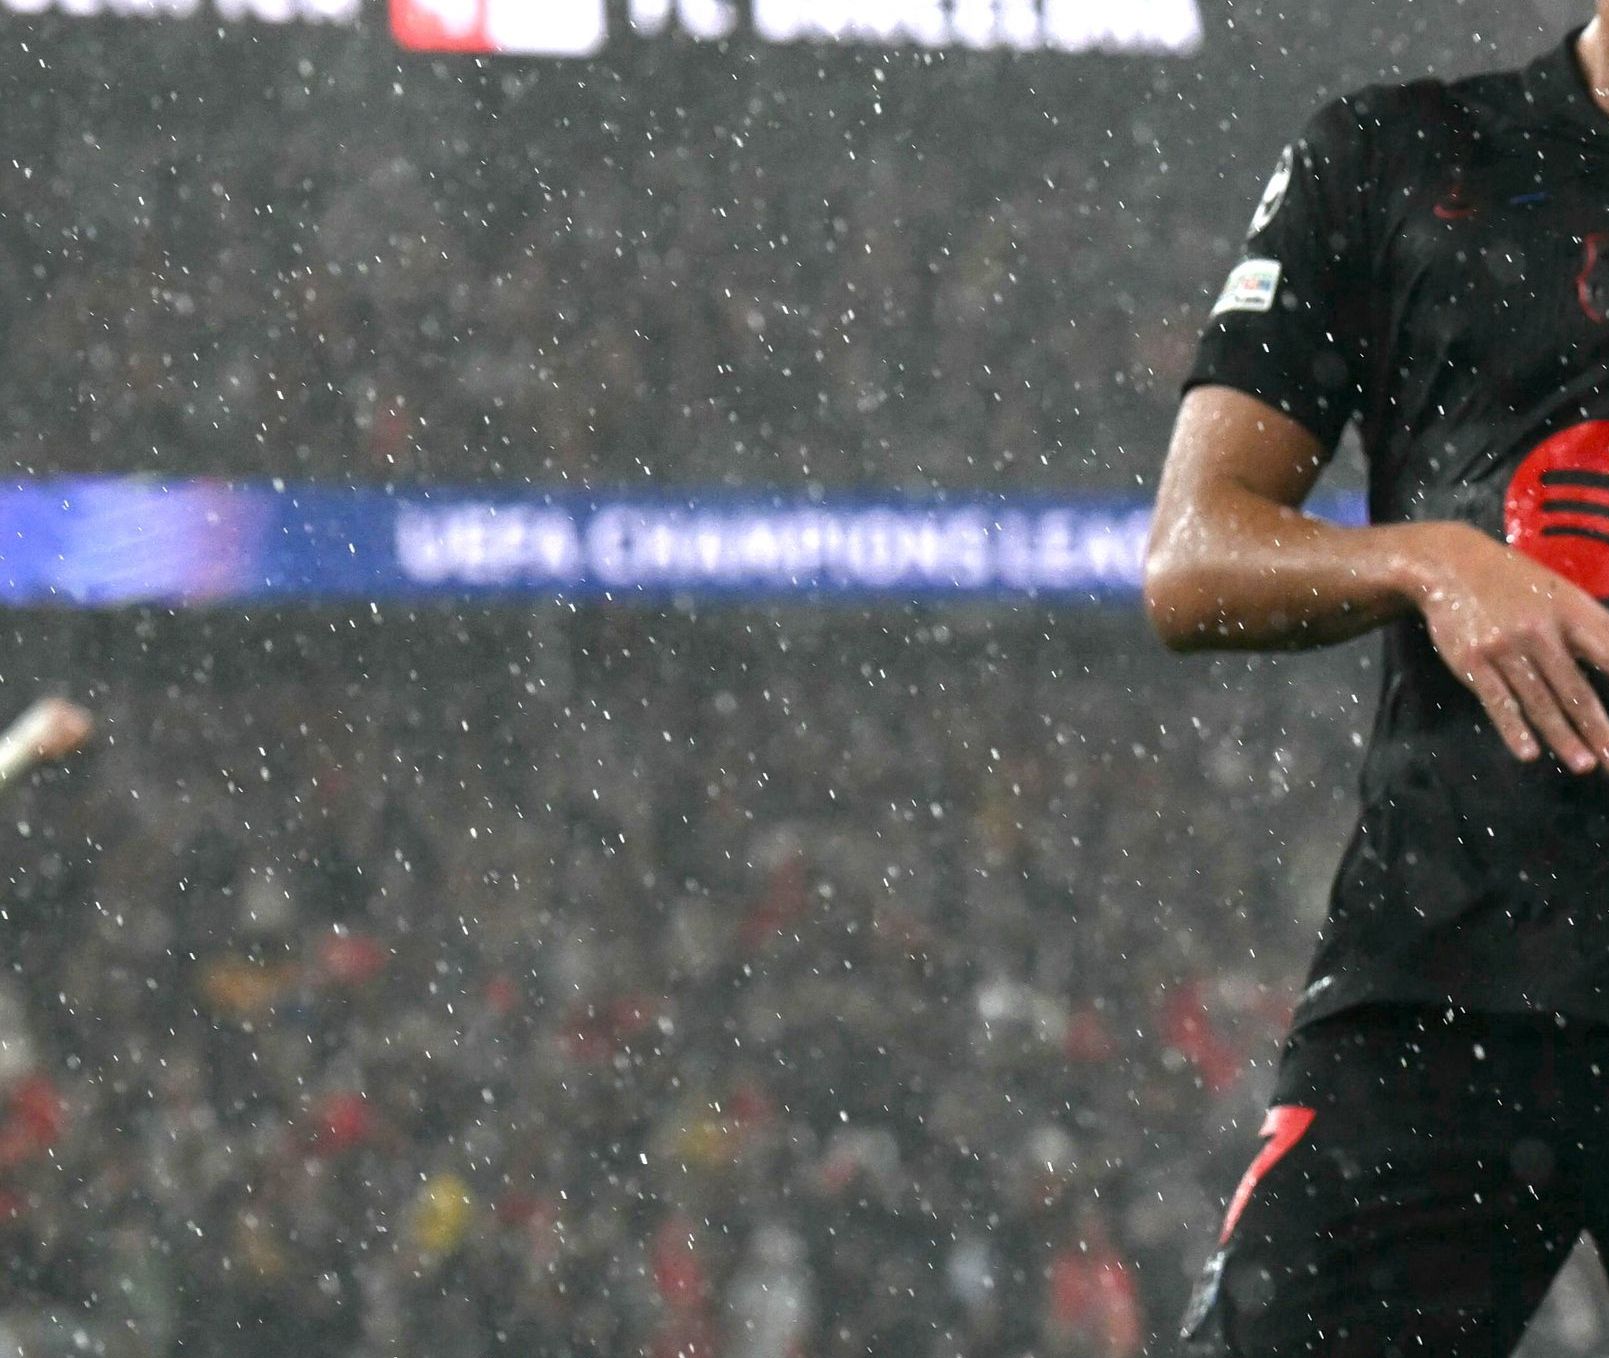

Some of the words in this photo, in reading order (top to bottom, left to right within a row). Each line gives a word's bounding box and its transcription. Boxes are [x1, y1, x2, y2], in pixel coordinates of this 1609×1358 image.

[396, 507, 578, 582] UEFA
[587, 507, 990, 584] CHAMPIONS
[998, 507, 1150, 584] LEA
